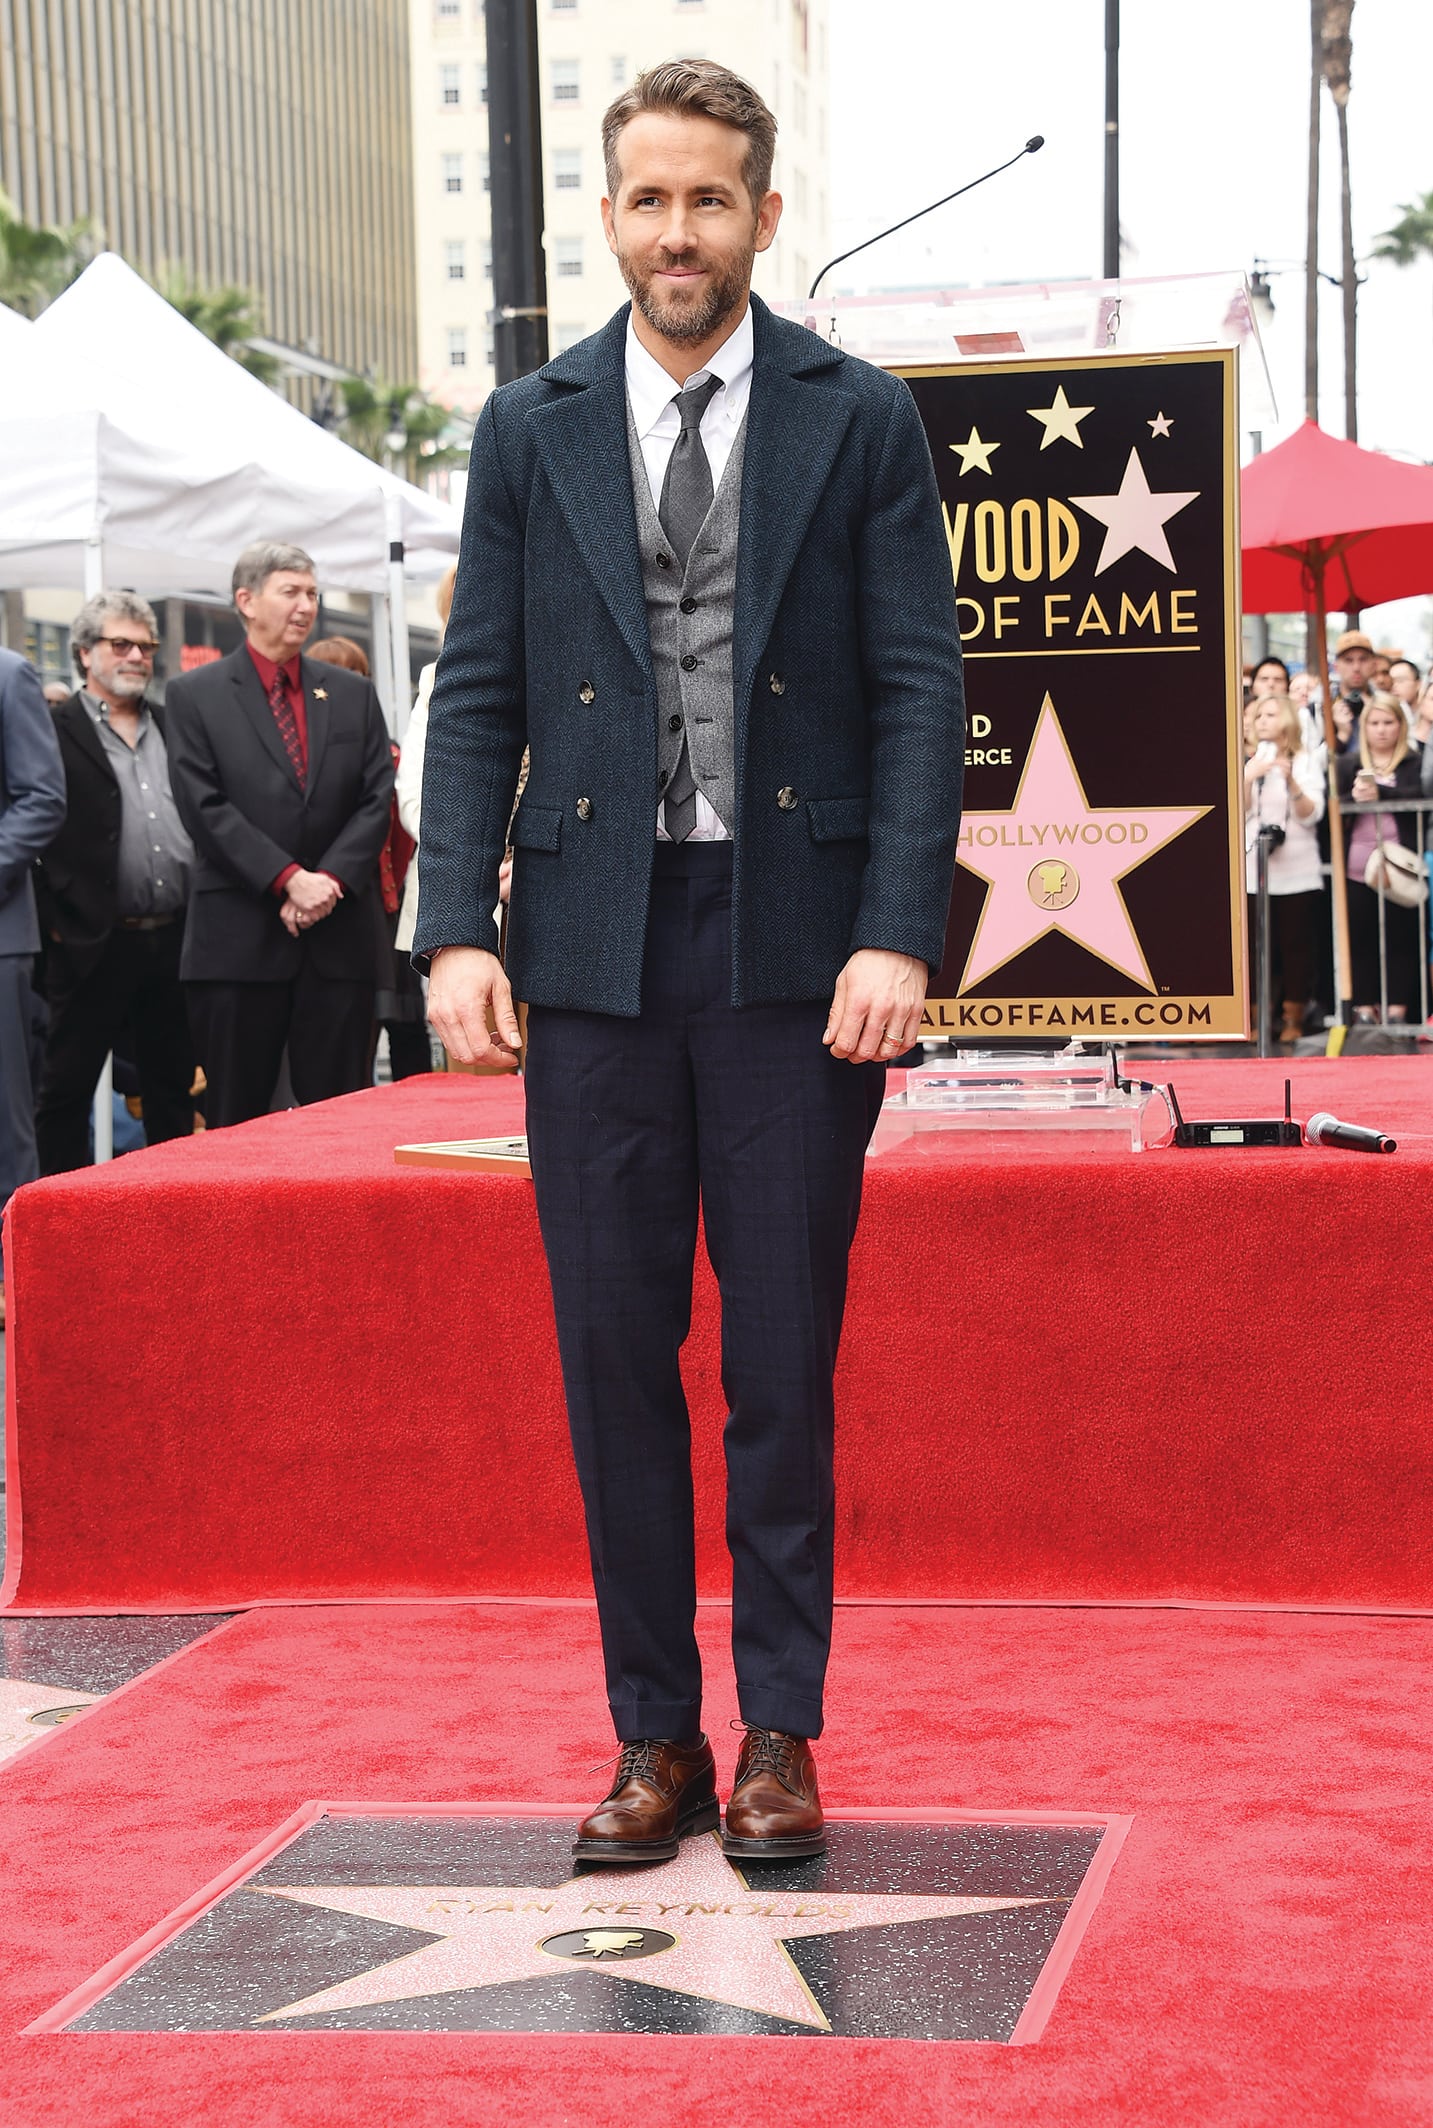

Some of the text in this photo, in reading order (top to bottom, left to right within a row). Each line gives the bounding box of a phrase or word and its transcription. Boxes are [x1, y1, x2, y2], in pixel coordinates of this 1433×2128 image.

[955, 590, 1198, 641] OF FAME
[957, 822, 1149, 848] HOLLYWOOD
[580, 1900, 857, 1919] REYNOLDS
